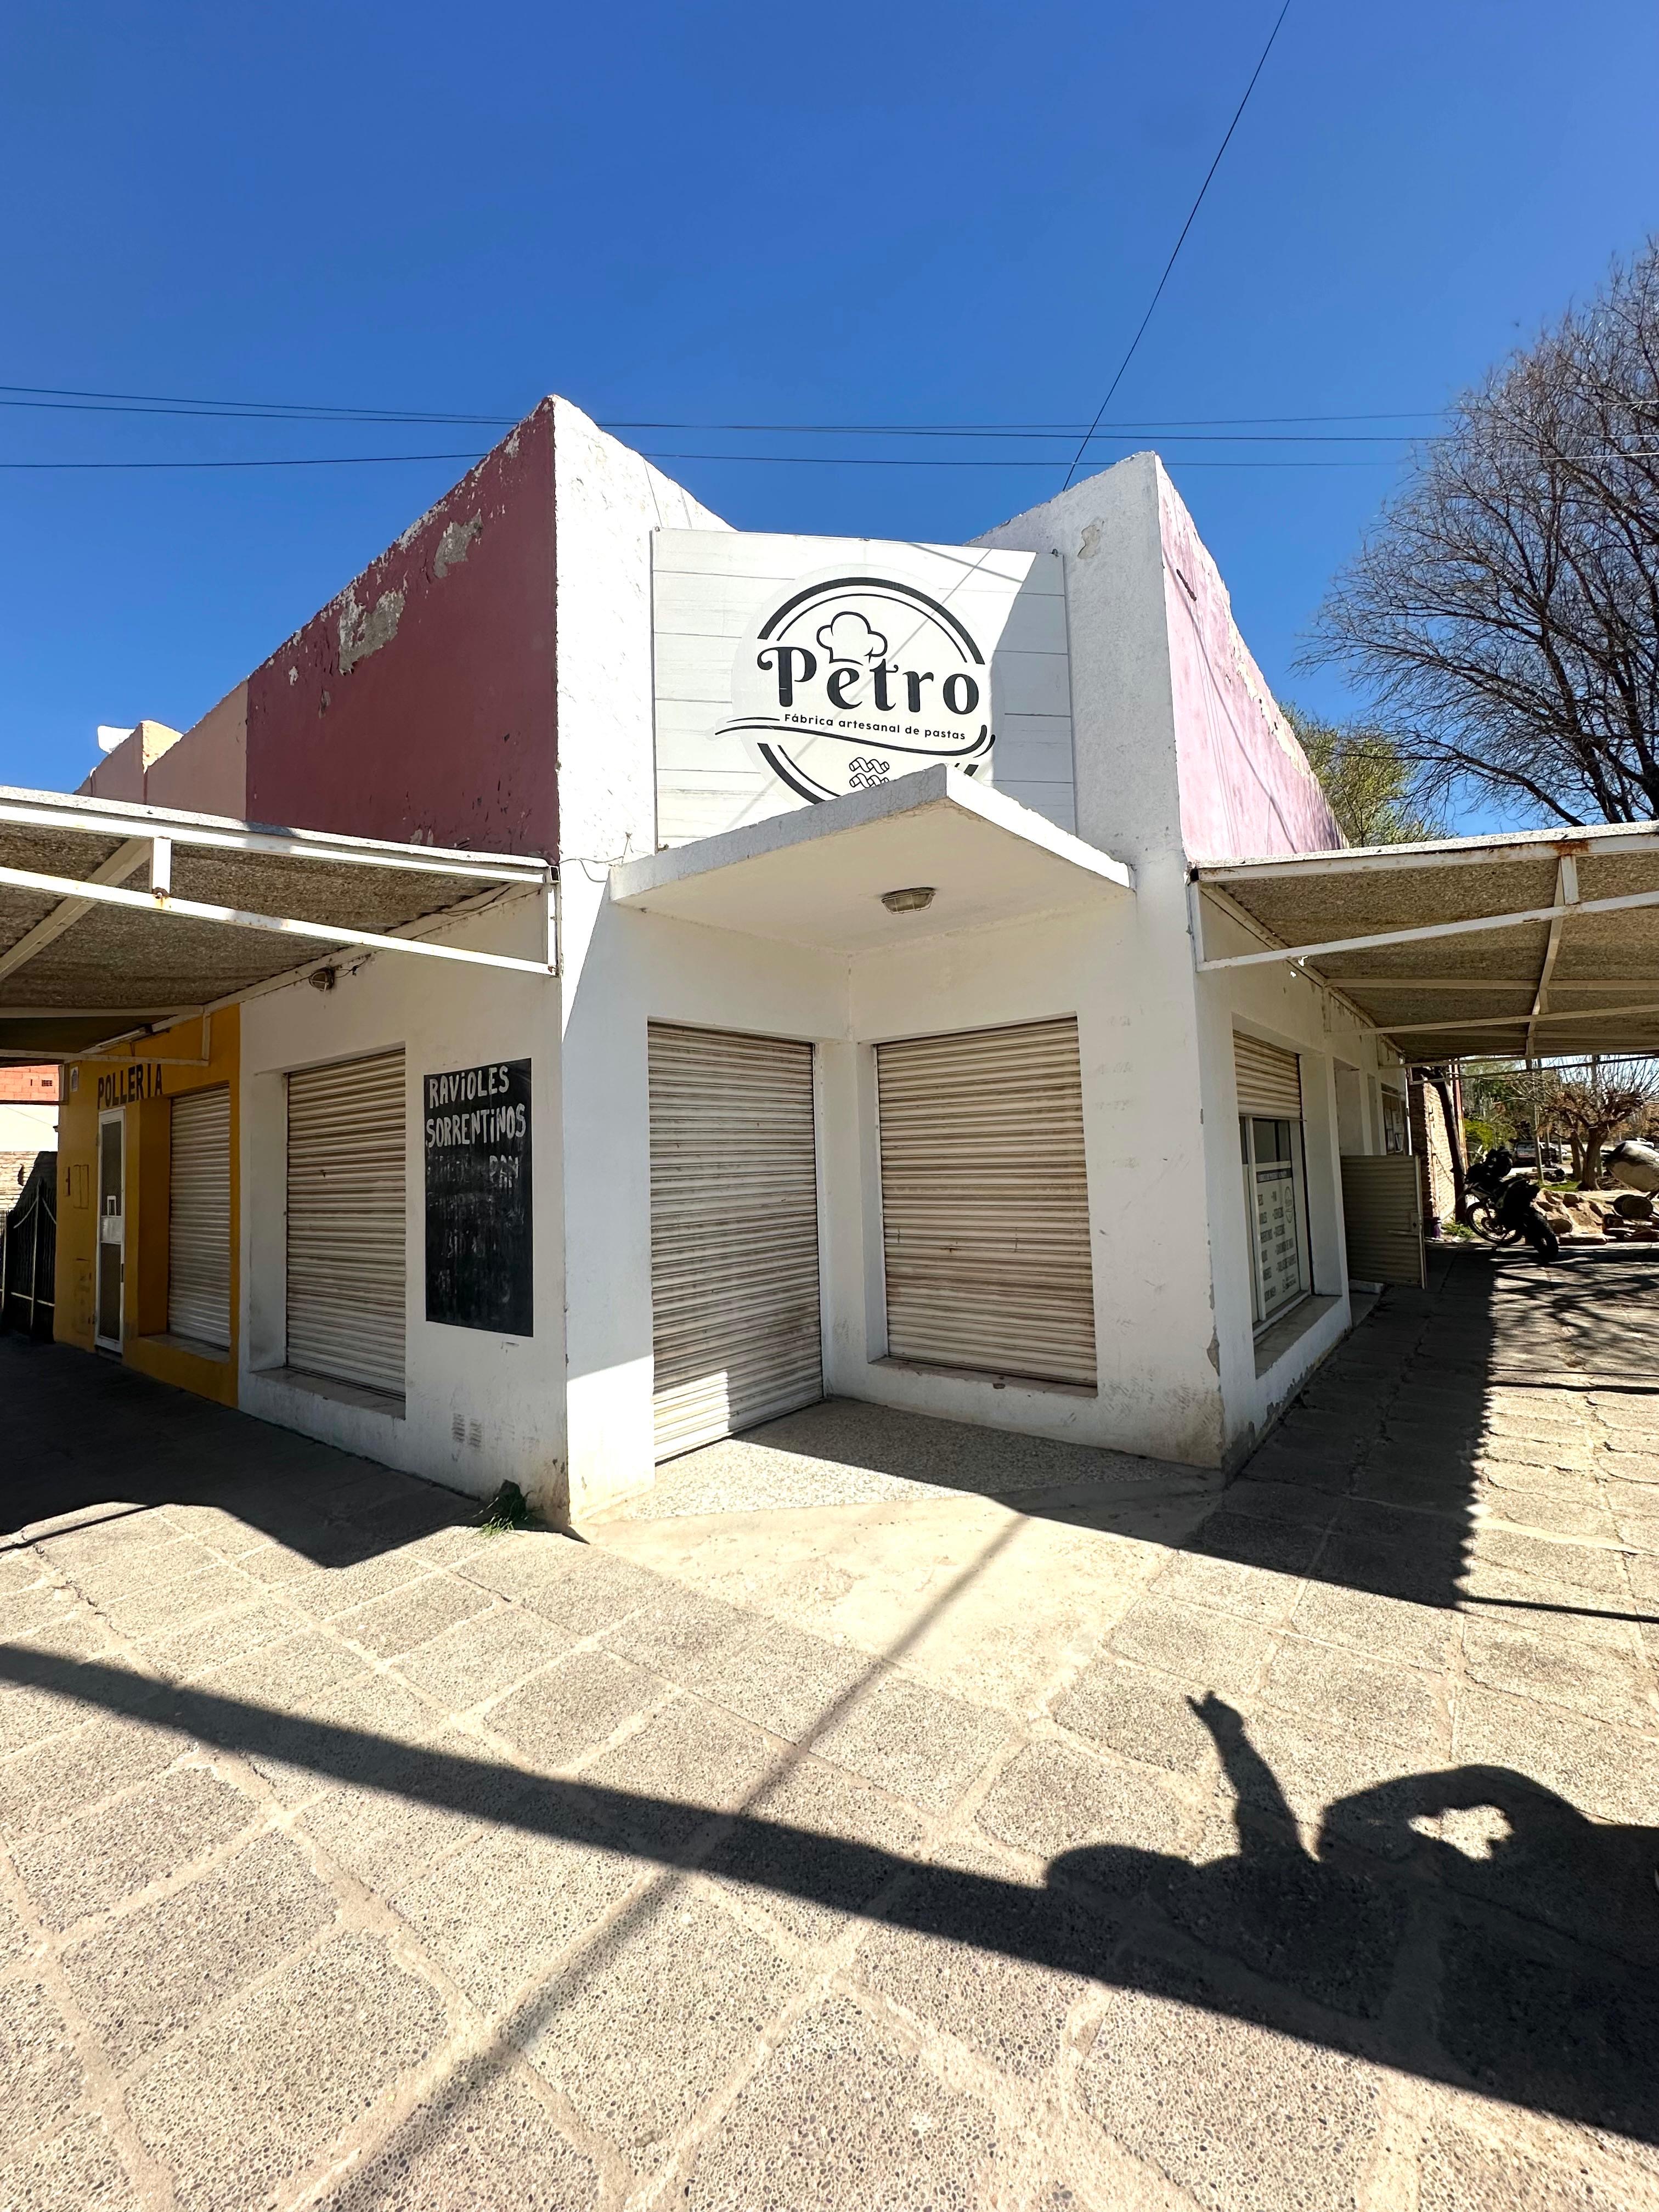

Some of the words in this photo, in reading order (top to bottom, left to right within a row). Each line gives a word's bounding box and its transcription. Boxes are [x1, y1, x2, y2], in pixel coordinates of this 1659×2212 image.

[757, 646, 979, 715] Petro
[785, 714, 833, 726] Fábrica
[839, 721, 900, 733] artesanal
[905, 726, 919, 735] de
[925, 730, 965, 740] pastas
[98, 1063, 163, 1110] POLLERIA
